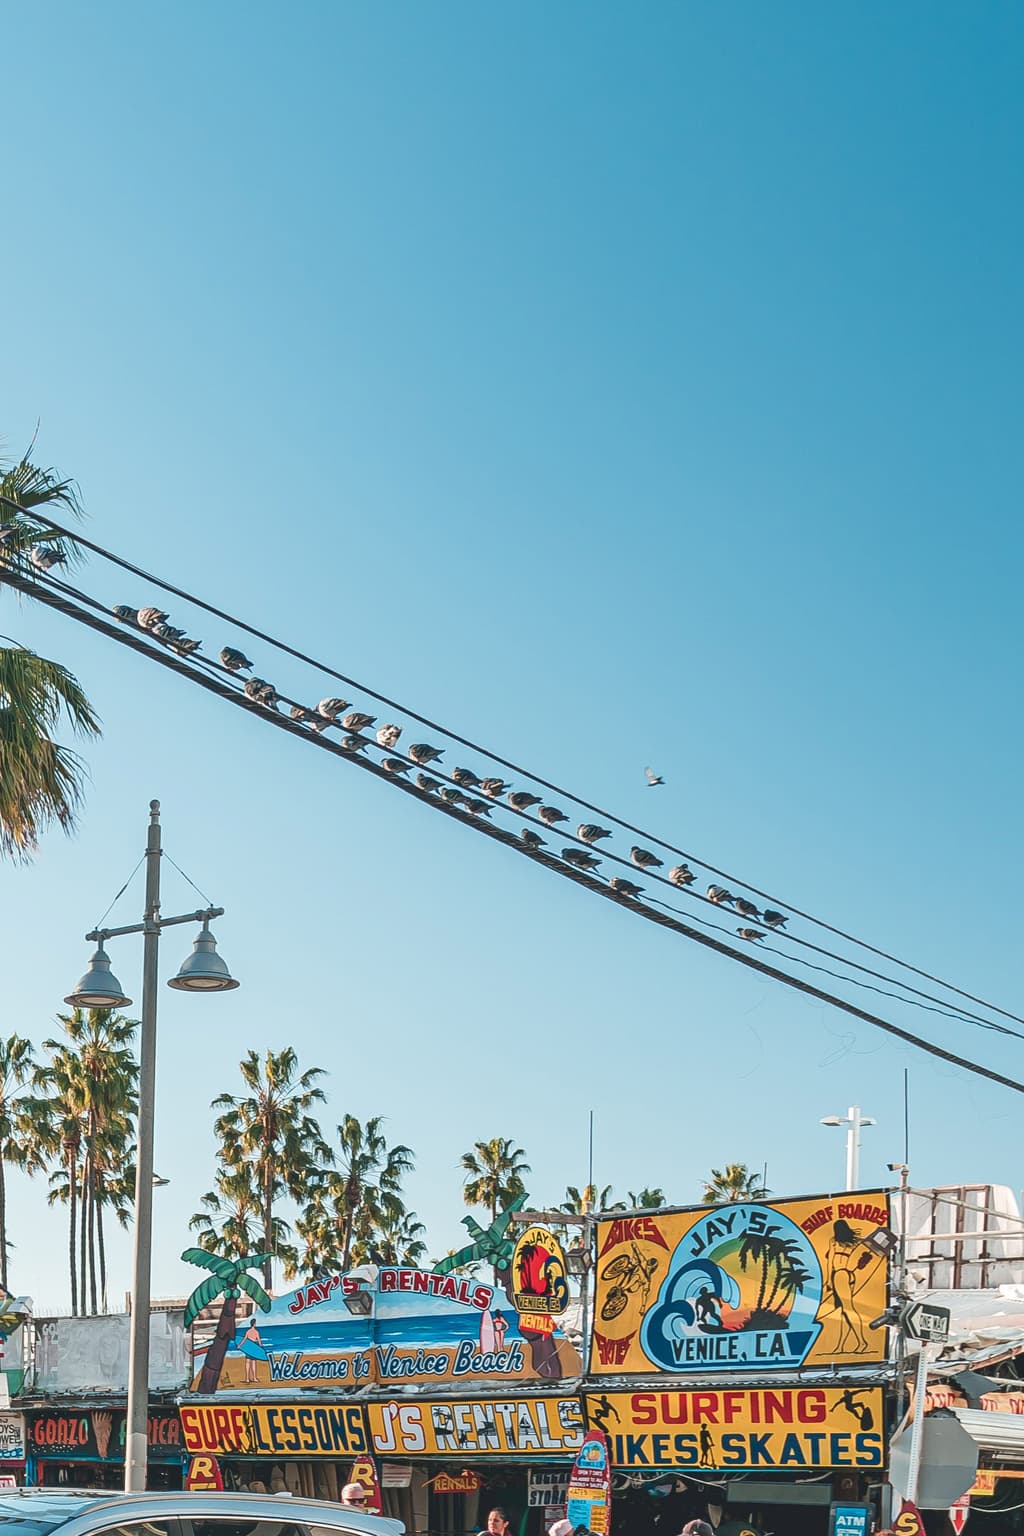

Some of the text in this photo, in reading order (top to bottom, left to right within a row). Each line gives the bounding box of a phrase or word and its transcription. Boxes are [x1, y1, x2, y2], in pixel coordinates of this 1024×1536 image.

[689, 1209, 768, 1257] JAY'S
[801, 1203, 890, 1235] SURF BOARDS
[598, 1217, 671, 1259] BIKES
[289, 1270, 493, 1314] JAY'S RENTALS
[520, 1313, 554, 1333] RENTALS
[265, 1351, 349, 1381] Welcome
[352, 1352, 371, 1378] to
[377, 1343, 450, 1378] Venice
[452, 1339, 524, 1376] Beach
[756, 1332, 786, 1357] CA
[631, 1390, 827, 1425] SURFING
[34, 1418, 89, 1446] GONZO
[181, 1407, 365, 1452] SURF LESSONS
[374, 1400, 584, 1451] J'S RENTALS
[721, 1432, 882, 1465] SKATES
[434, 1477, 478, 1491] RENTALS
[530, 1490, 567, 1505] STORA
[836, 1515, 865, 1527] ATM
